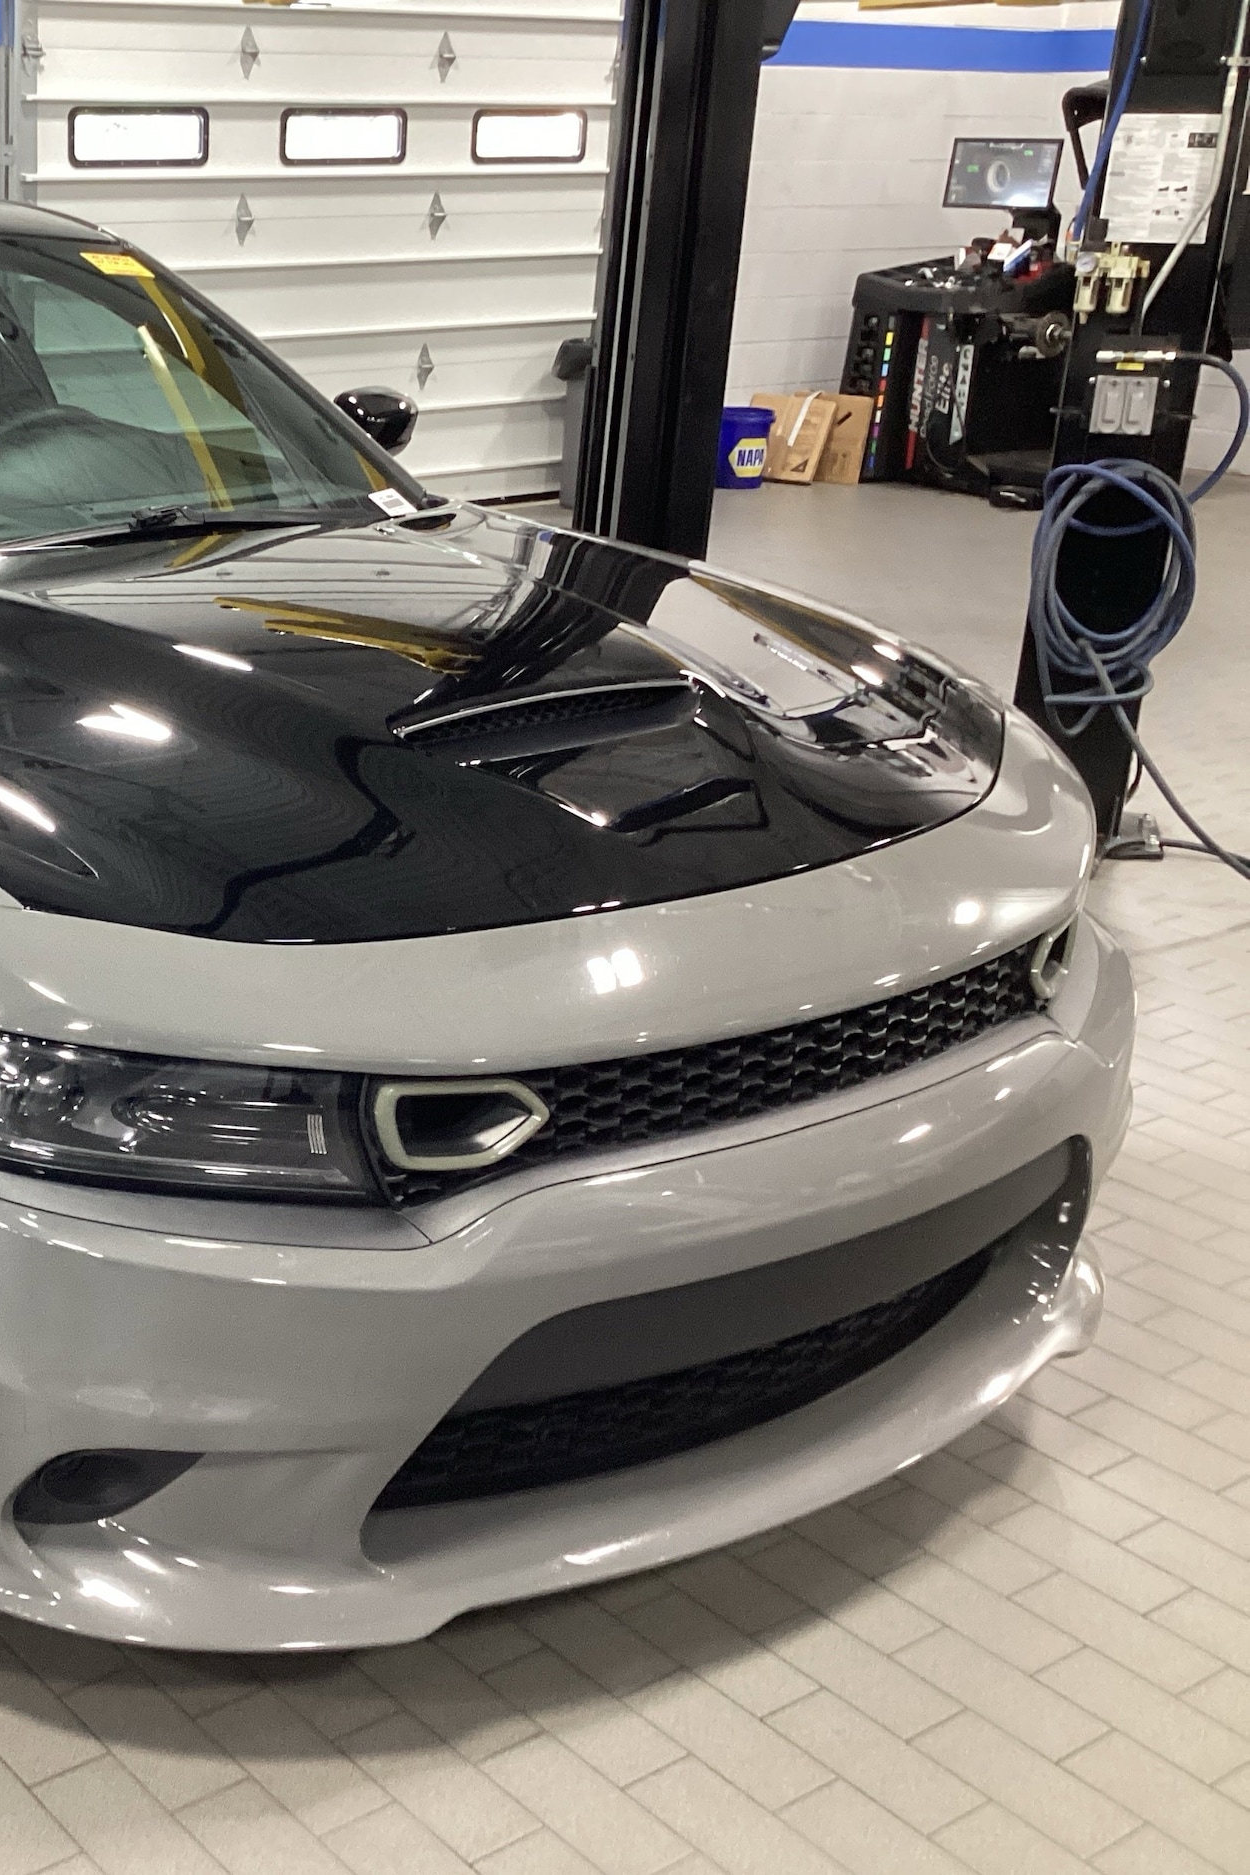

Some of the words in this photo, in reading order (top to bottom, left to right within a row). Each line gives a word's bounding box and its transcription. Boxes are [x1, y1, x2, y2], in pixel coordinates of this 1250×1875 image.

[908, 338, 928, 432] HUNTER
[935, 362, 953, 414] Elite
[737, 449, 764, 466] NAPA
